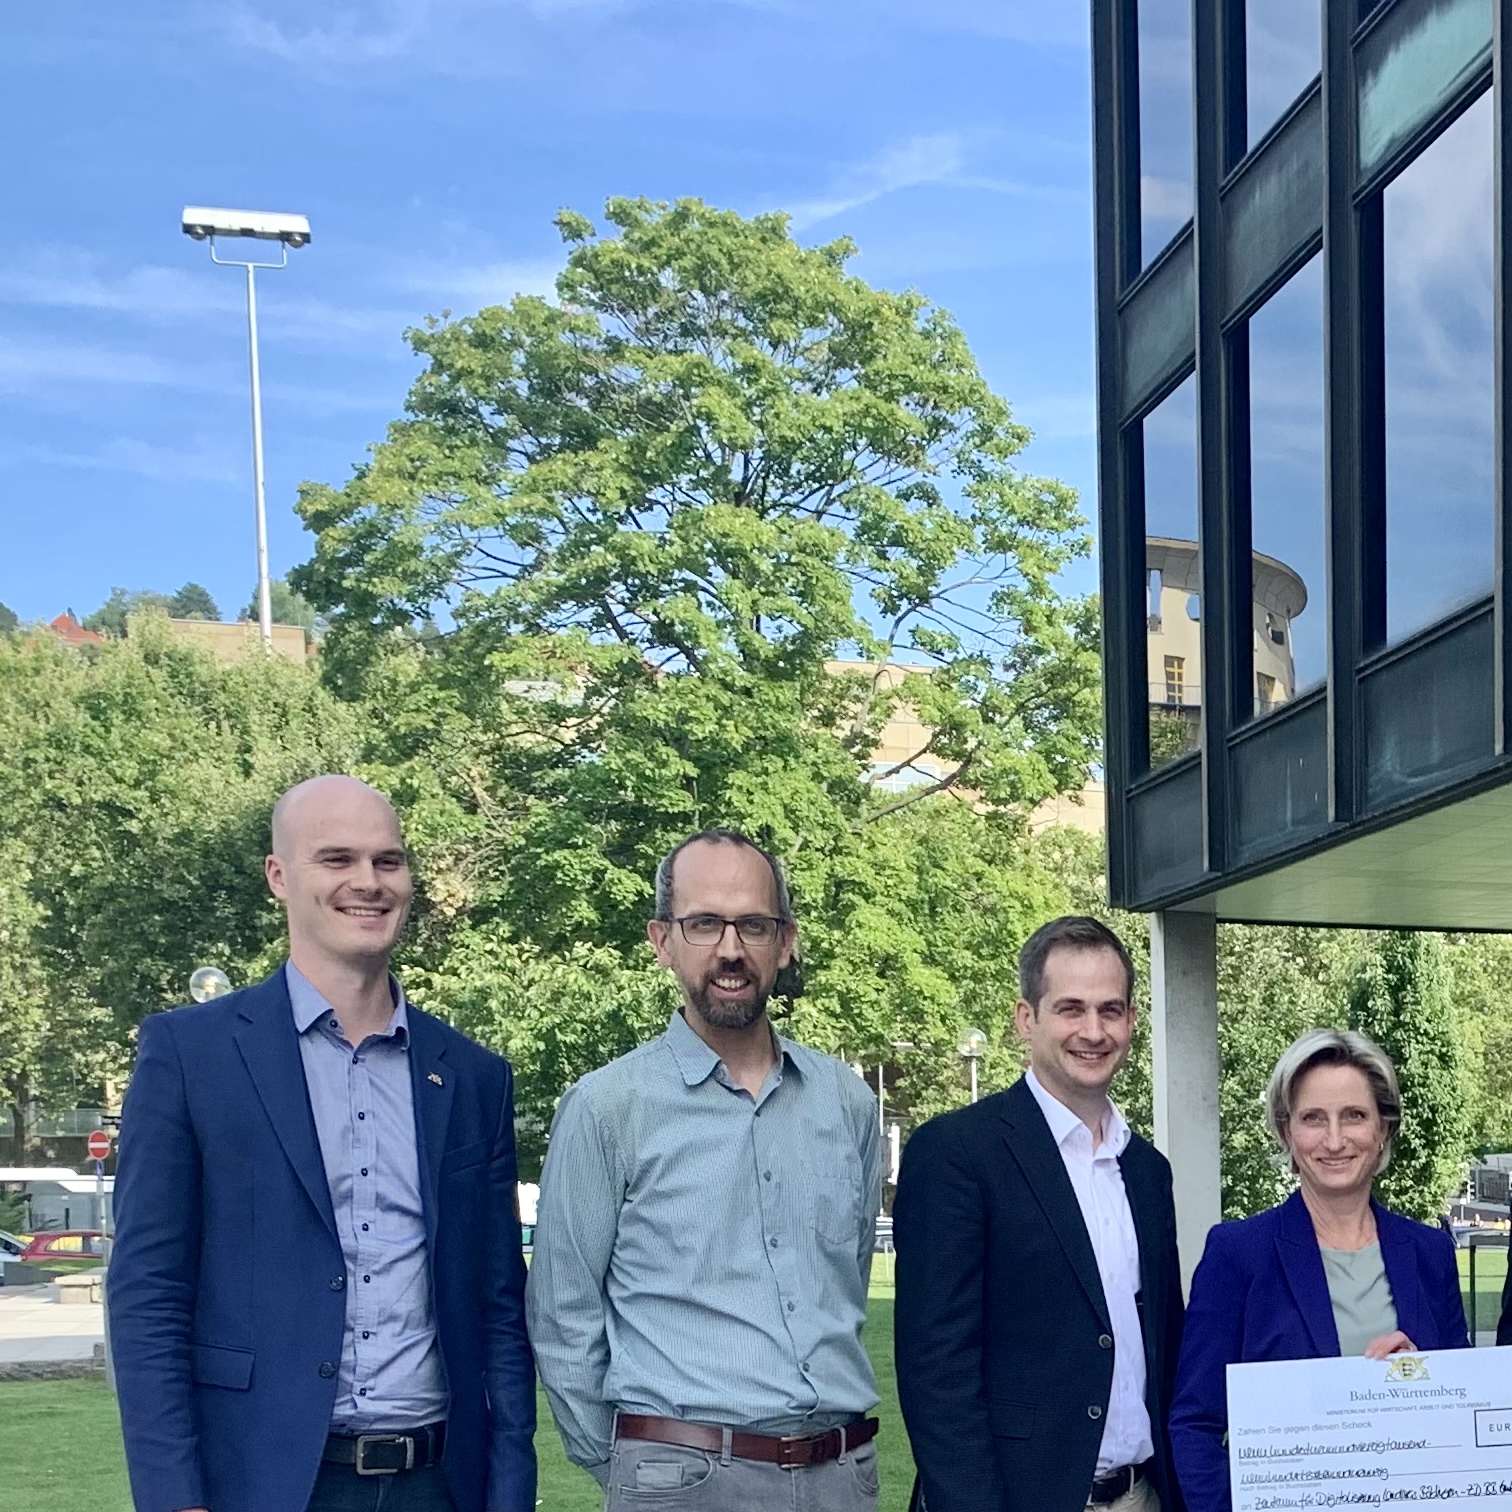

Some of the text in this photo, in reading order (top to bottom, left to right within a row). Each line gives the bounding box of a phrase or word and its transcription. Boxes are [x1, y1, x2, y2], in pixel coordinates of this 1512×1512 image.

[1350, 1385, 1467, 1402] Baden-Württemberg
[1326, 1408, 1366, 1416] MINISTERIUM
[1456, 1401, 1492, 1409] TOURISMUS
[1237, 1420, 1372, 1436] Zahlen Sie gegen diesen Scheck
[1489, 1422, 1512, 1433] EUR
[1240, 1503, 1252, 1511] an
